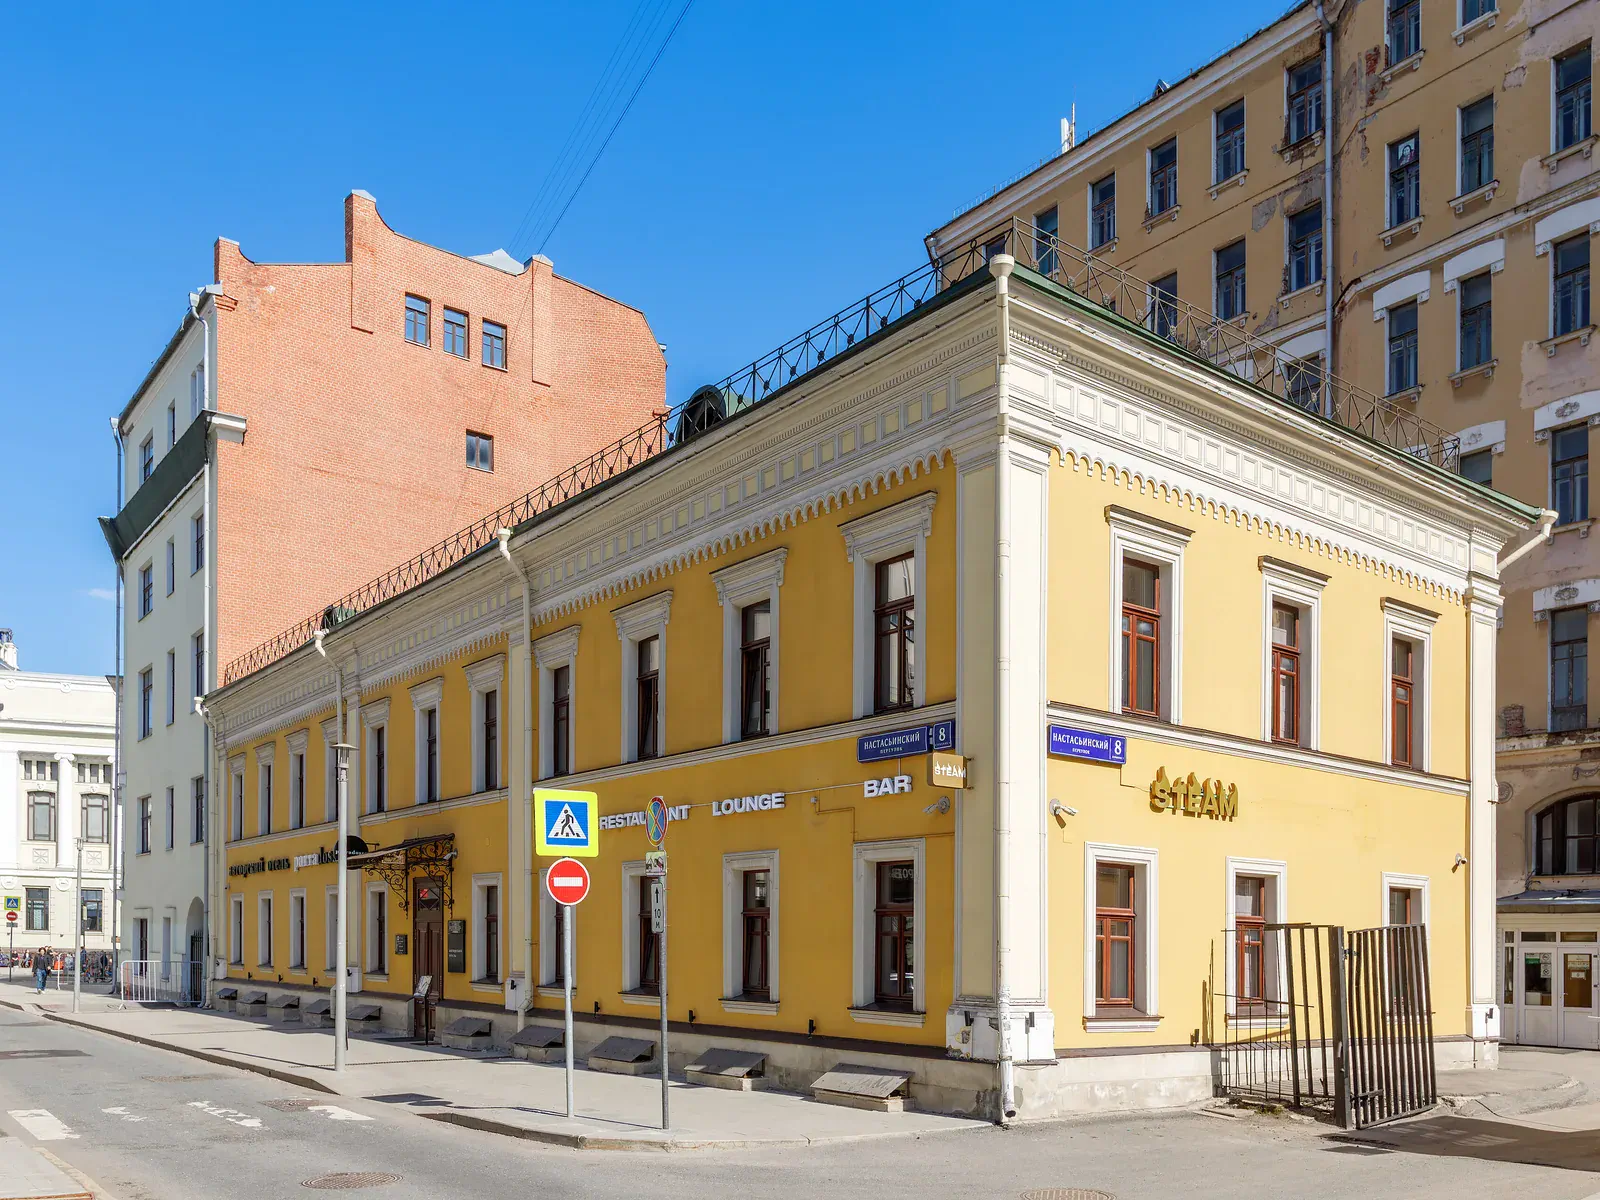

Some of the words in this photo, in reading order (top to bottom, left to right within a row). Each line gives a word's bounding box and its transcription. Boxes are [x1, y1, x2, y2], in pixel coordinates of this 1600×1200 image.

[864, 731, 920, 750] НАСТАСЬИНСКИЙ
[939, 727, 946, 741] 8
[1052, 732, 1109, 750] НАСТАСЬИНСКИЙ
[1114, 740, 1122, 755] 8
[934, 761, 966, 778] STEAM
[1154, 766, 1238, 818] STEAM
[599, 805, 690, 830] RESTAUNT
[712, 792, 785, 817] LOUNGE
[863, 774, 912, 798] BAR
[654, 908, 661, 919] 10
